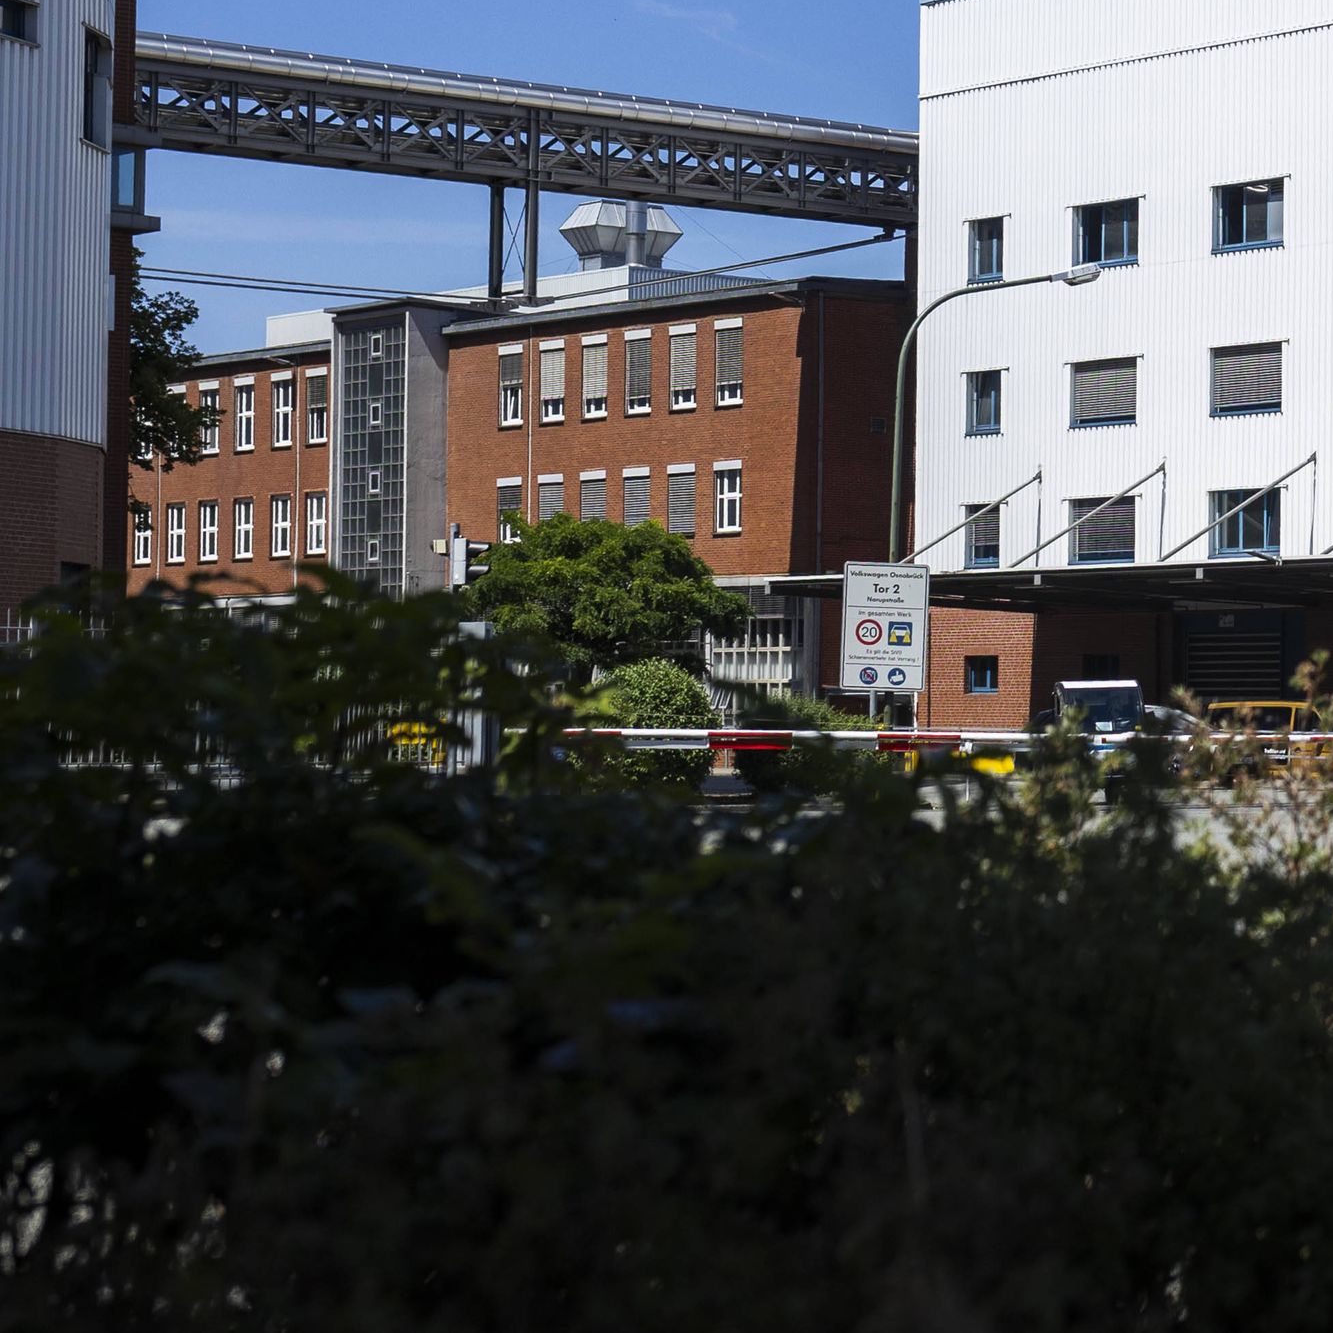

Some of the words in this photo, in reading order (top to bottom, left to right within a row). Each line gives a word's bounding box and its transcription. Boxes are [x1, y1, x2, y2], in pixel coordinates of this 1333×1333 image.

[850, 570, 888, 578] Volkswagen
[889, 571, 923, 579] Osnabrück
[873, 583, 889, 593] Tor
[893, 584, 900, 594] 2
[861, 626, 878, 638] 20
